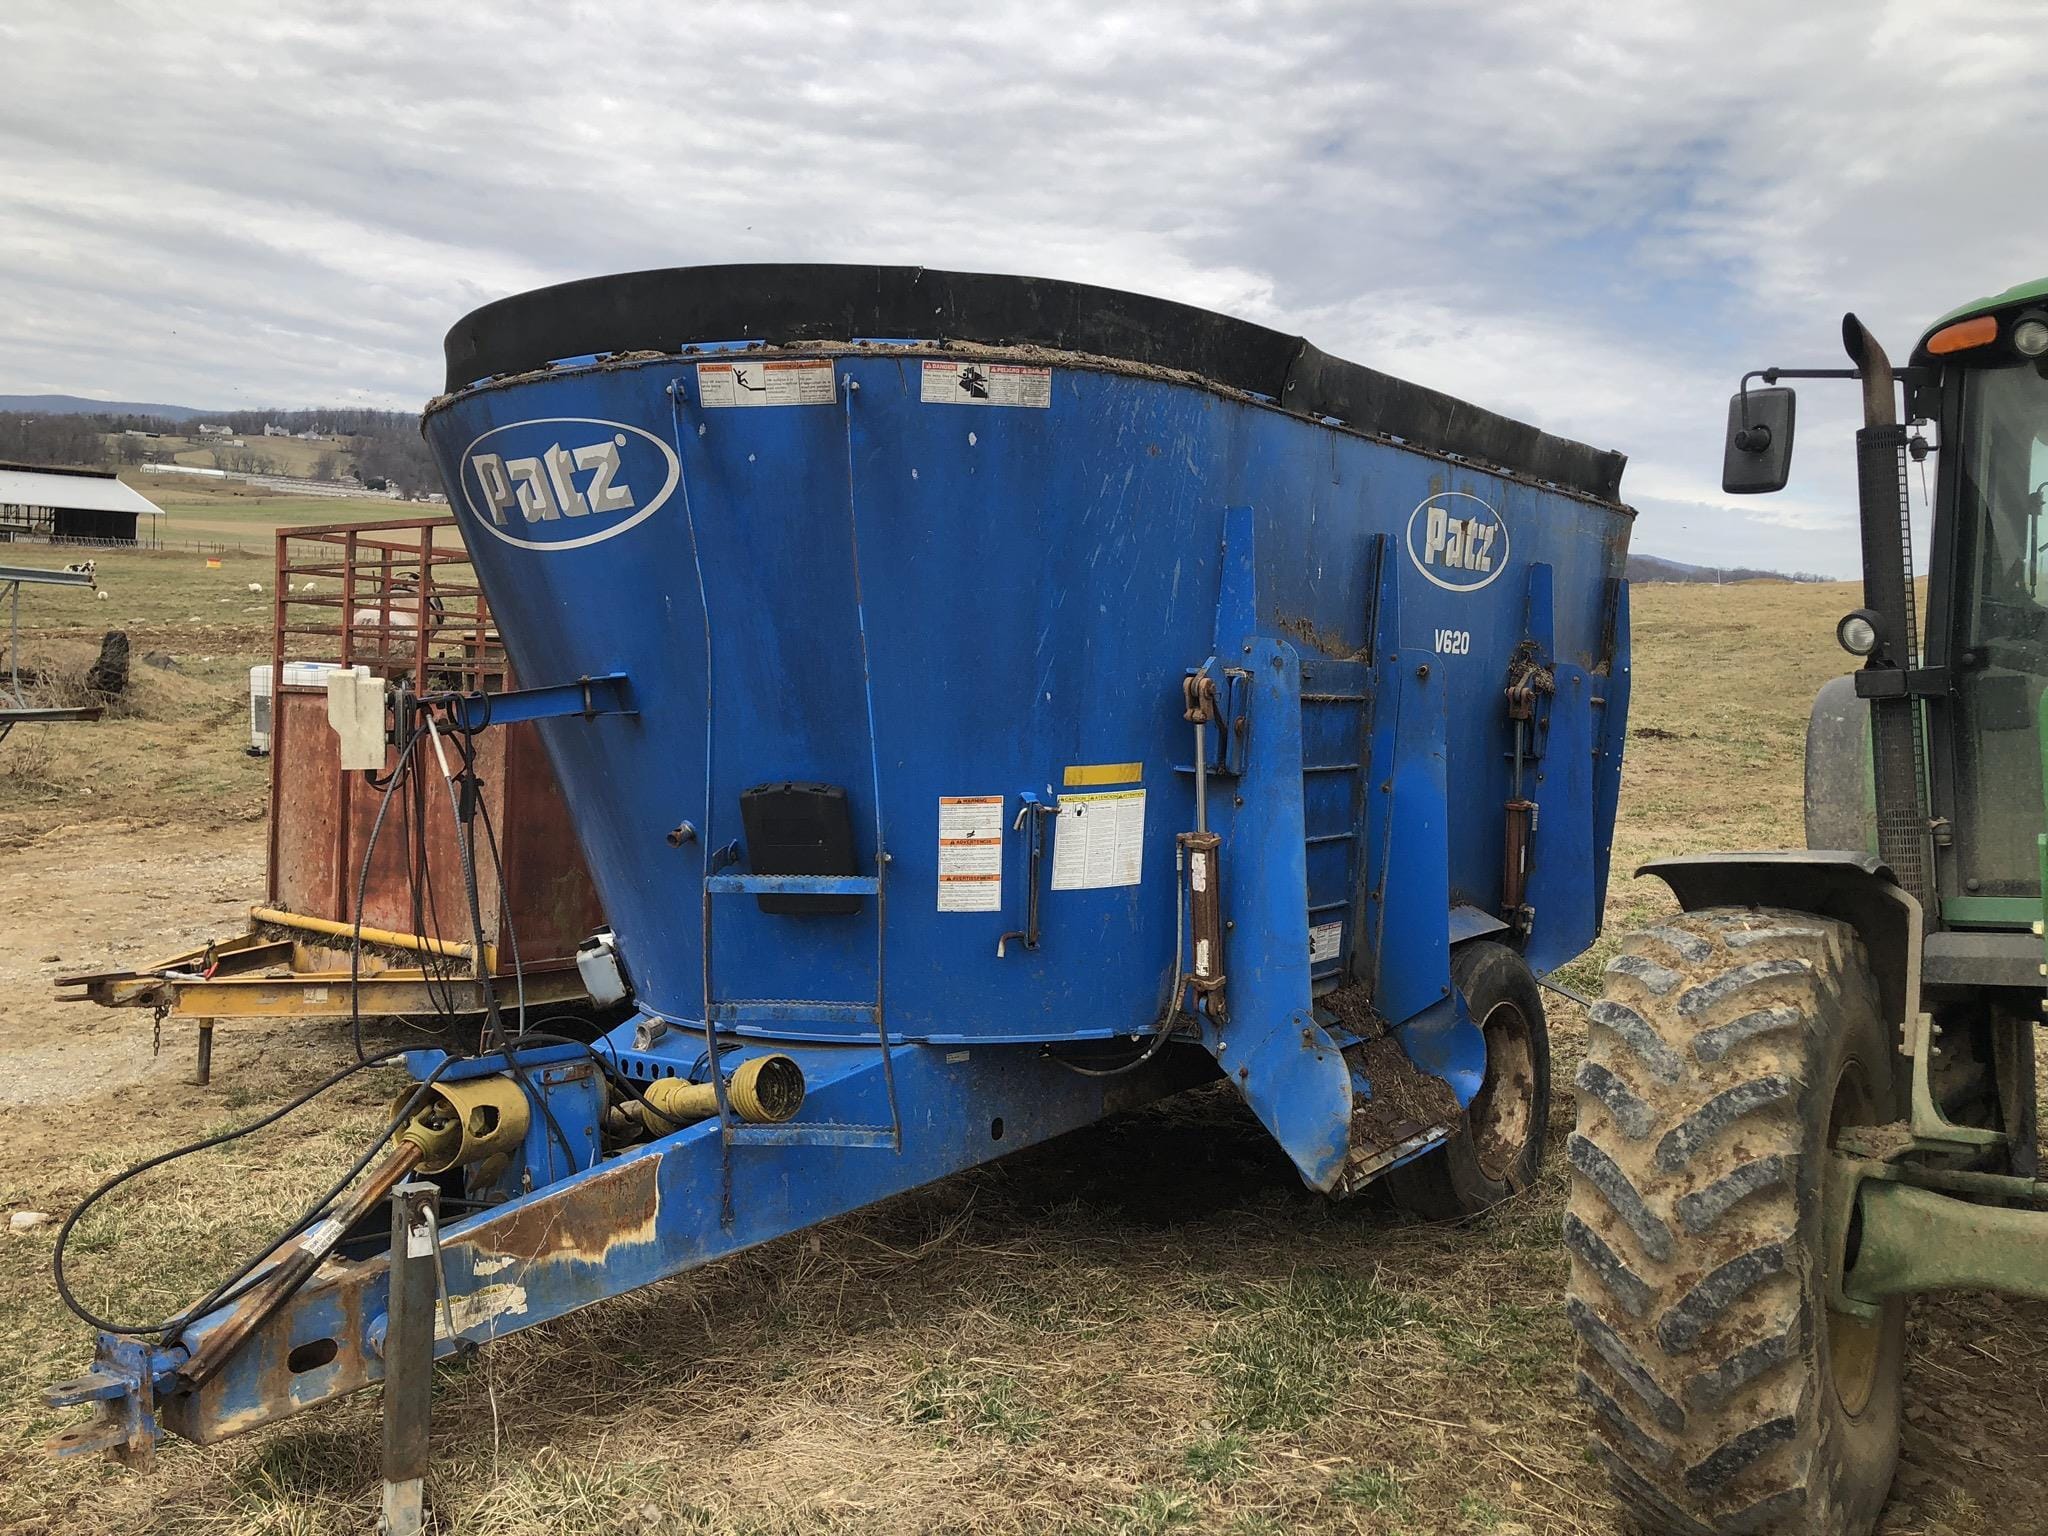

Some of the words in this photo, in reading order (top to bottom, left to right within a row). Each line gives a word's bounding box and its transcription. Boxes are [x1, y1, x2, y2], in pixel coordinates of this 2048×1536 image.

[471, 441, 635, 525] Patz
[1424, 507, 1495, 572] Patz
[1435, 628, 1470, 654] V620
